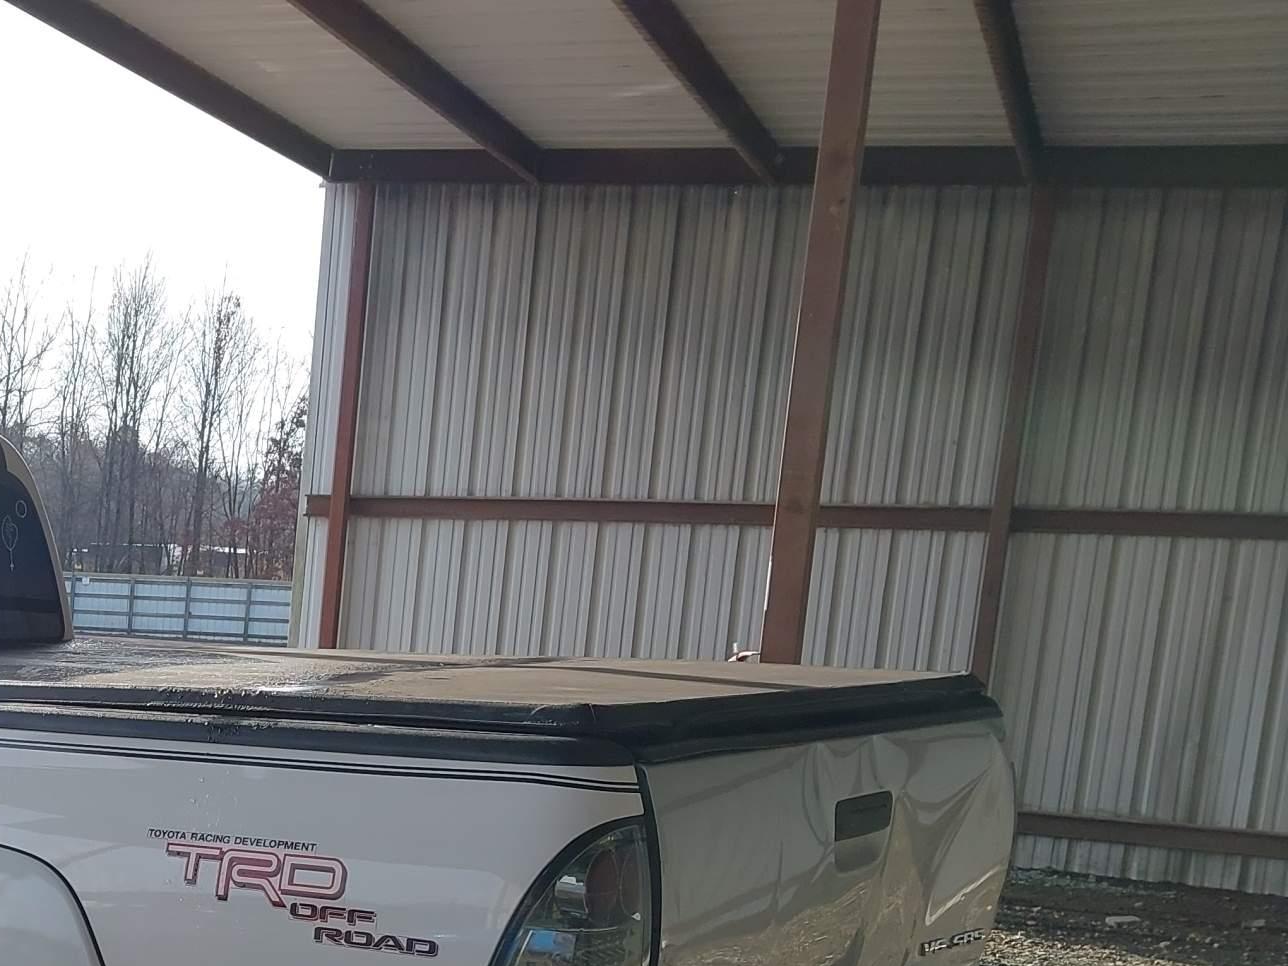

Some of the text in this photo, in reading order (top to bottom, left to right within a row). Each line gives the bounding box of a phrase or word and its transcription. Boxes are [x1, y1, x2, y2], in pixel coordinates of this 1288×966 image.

[148, 828, 318, 852] TOYOTA RACING DEVELOPMENT
[165, 842, 349, 909] TRD
[289, 901, 378, 927] OFF
[312, 926, 440, 958] ROAD
